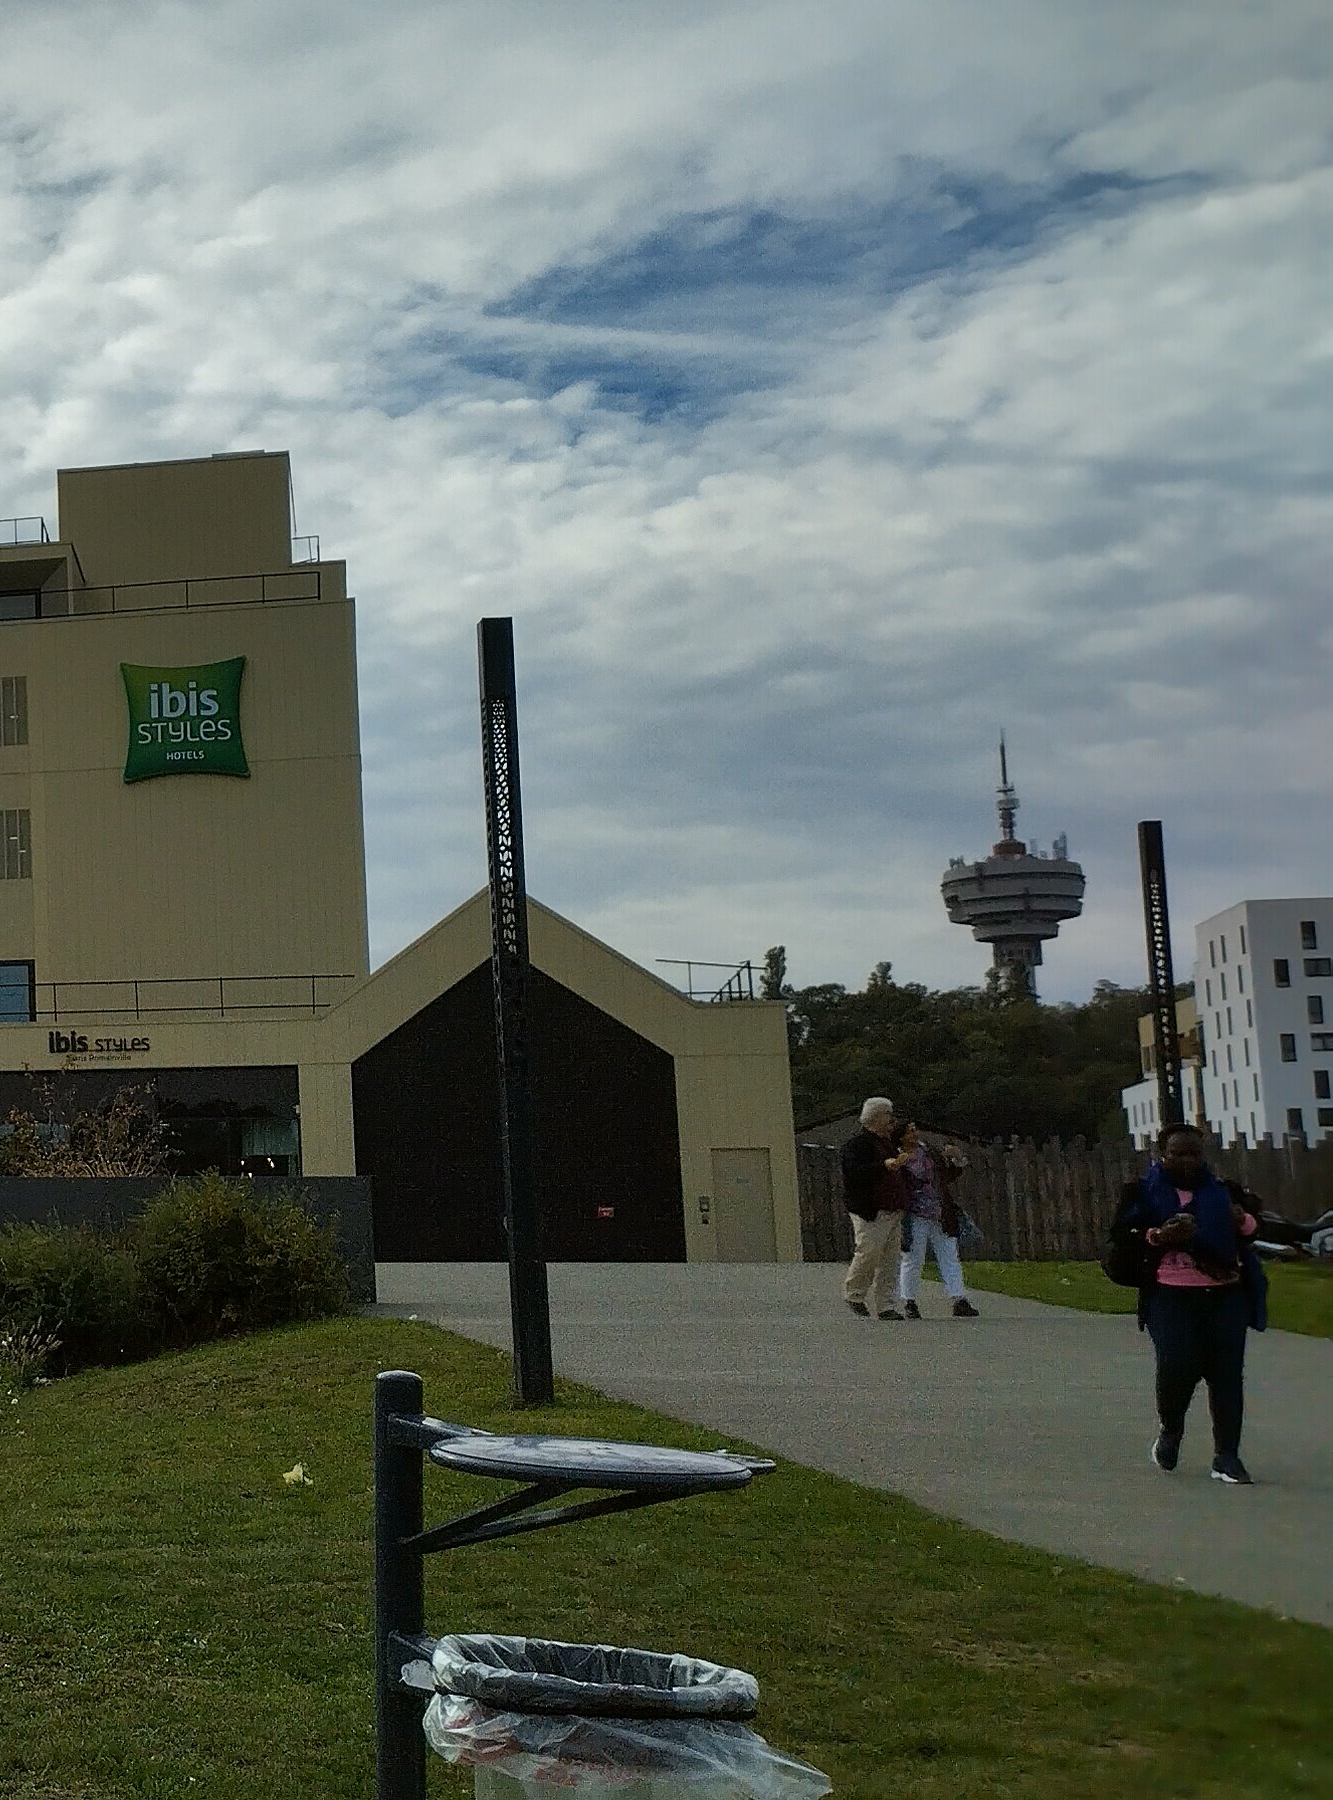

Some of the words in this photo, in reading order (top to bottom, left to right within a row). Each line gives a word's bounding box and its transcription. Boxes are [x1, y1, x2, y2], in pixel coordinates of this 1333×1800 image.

[149, 681, 219, 719] ibis
[166, 750, 205, 761] HOTELS
[49, 1030, 89, 1054] ibis
